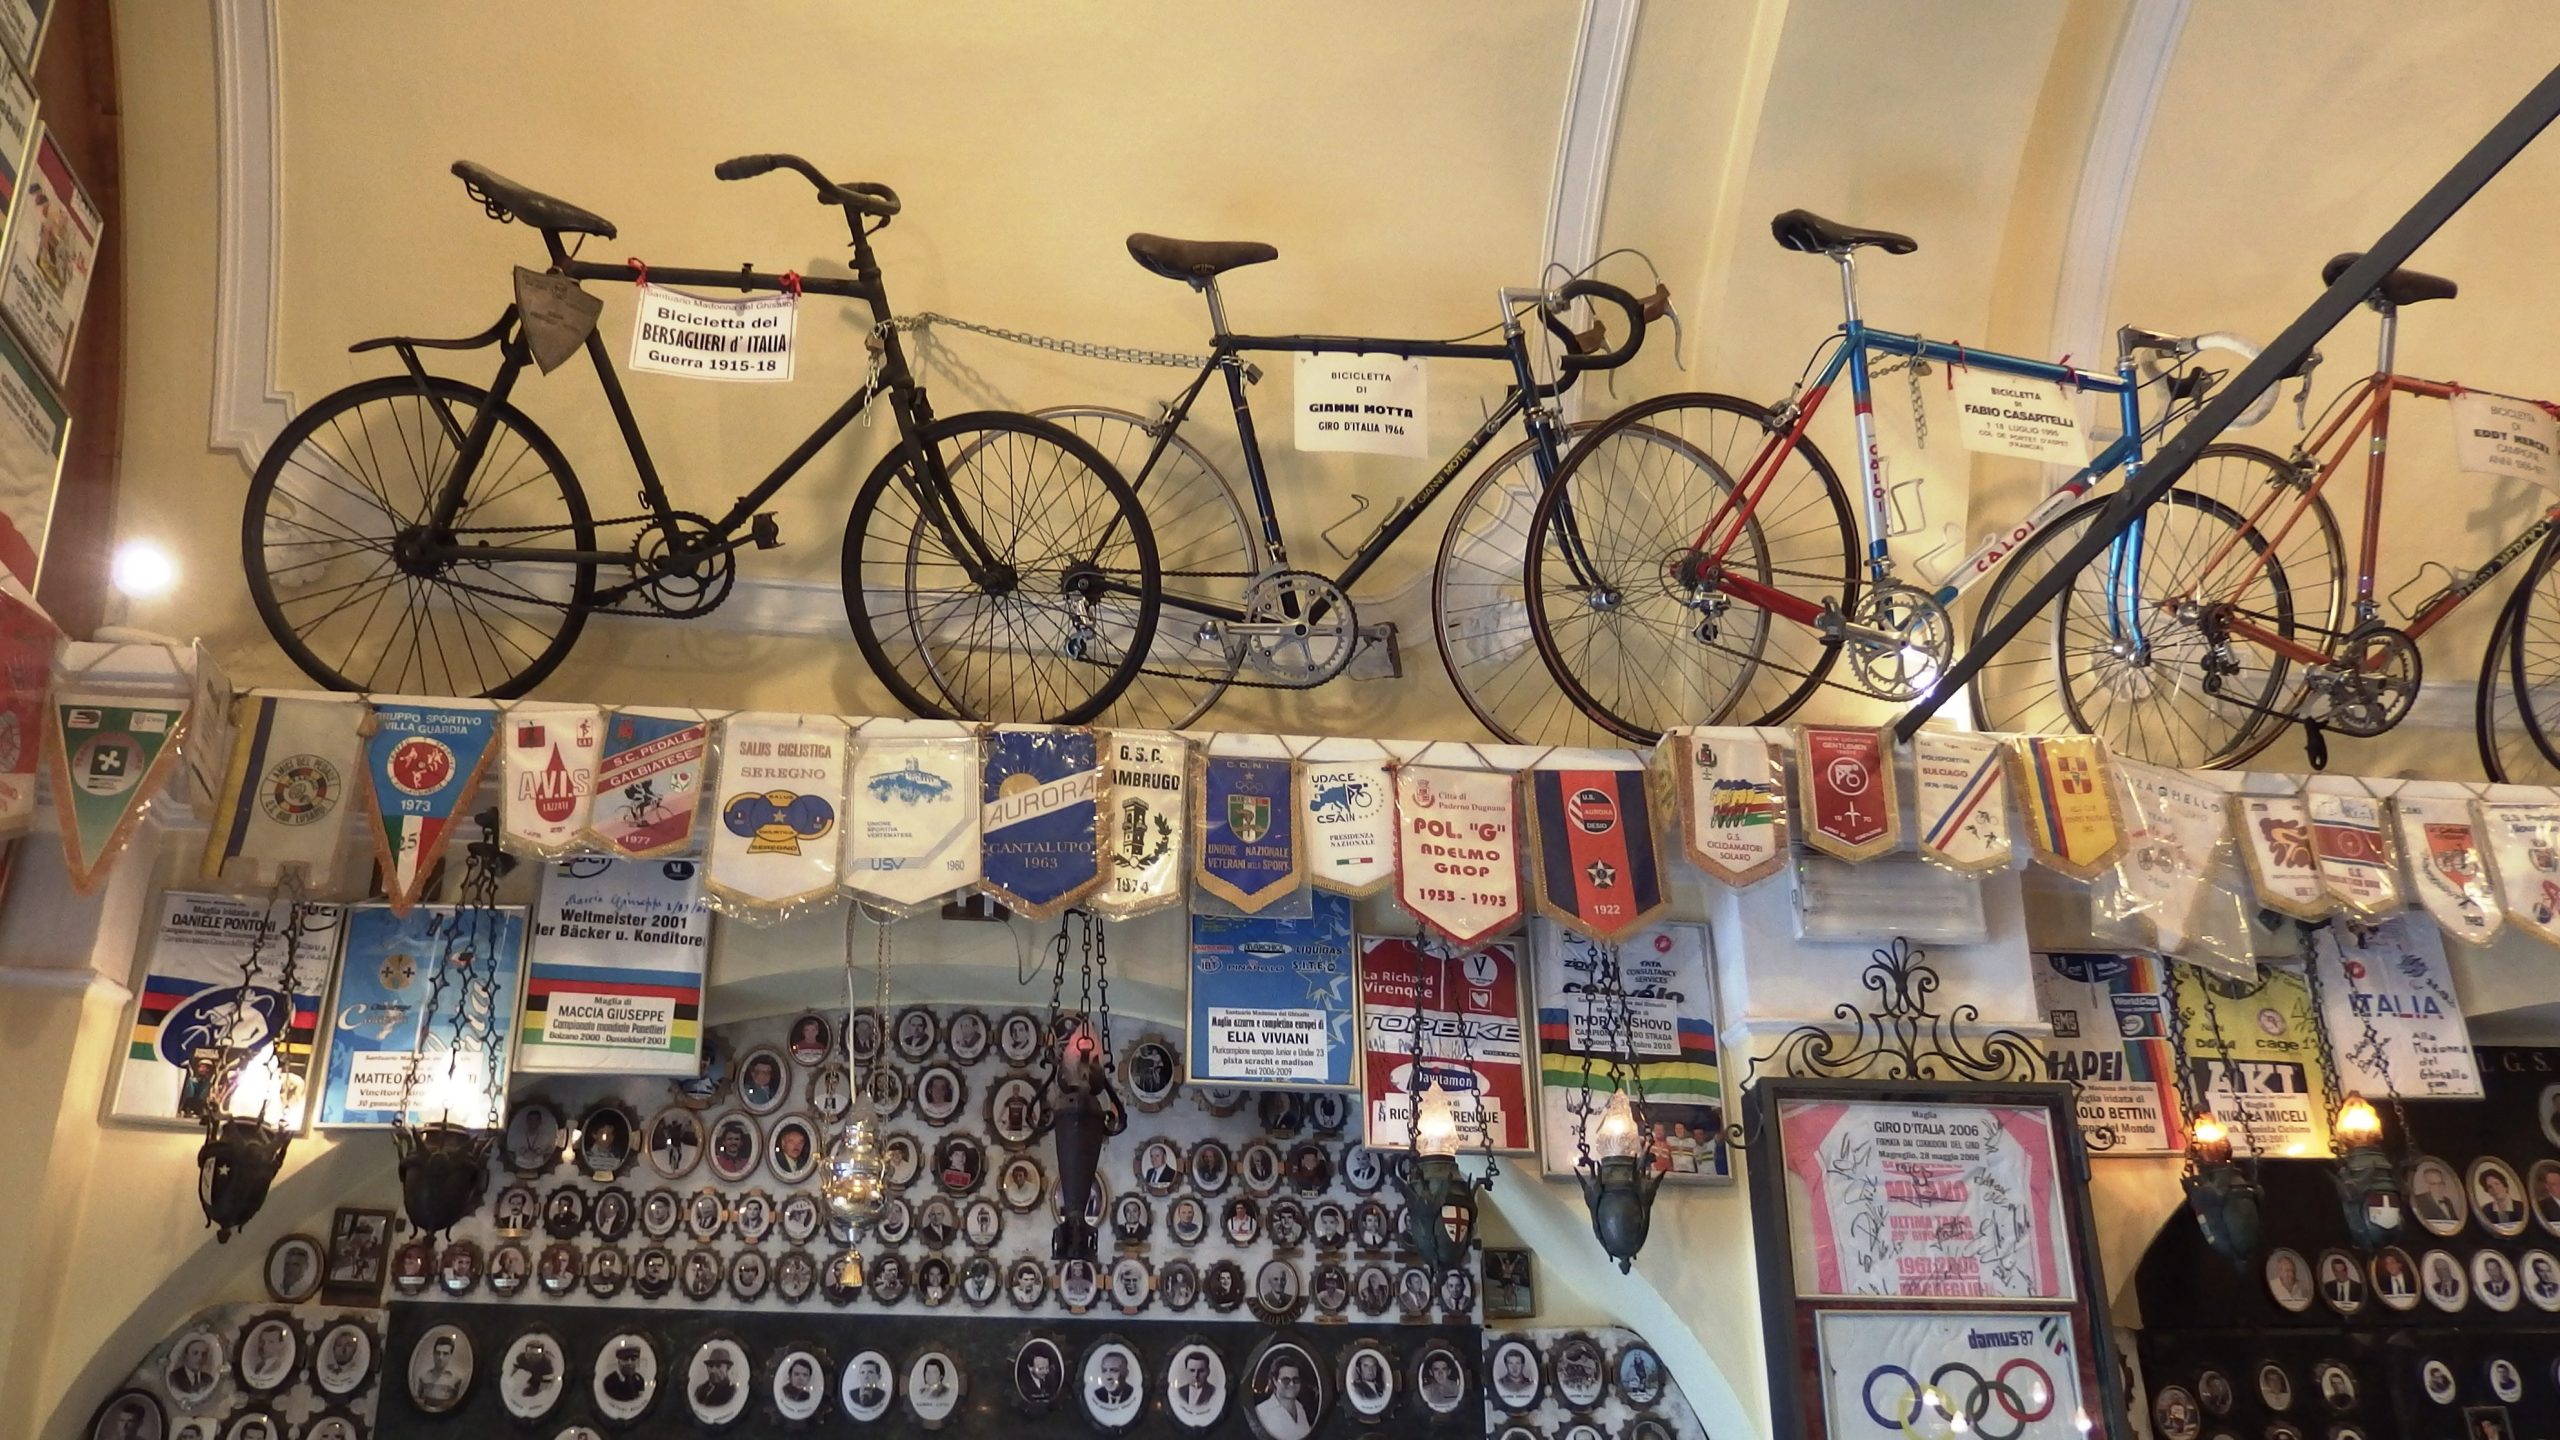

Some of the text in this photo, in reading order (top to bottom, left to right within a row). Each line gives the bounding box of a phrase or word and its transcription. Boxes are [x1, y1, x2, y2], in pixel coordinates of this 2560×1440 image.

[658, 307, 777, 329] Bicicletta dei
[643, 323, 725, 352] BERSAGLIERI
[747, 334, 786, 353] ITALIA
[649, 350, 776, 372] Guerra 1915-18
[1331, 372, 1392, 382] BICICLETTA
[1356, 386, 1367, 394] DI
[1990, 387, 2042, 401] BICICLETTA
[1309, 404, 1414, 418] GIANNI MOTTA
[1964, 404, 2074, 428] FABIO CASARTELLI
[1318, 421, 1405, 436] GIRO D'ITALIA 1966
[2008, 424, 2039, 435] LUGLIO
[1417, 447, 1472, 504] GIANNI MOTTA
[1976, 520, 2035, 573] CALOI
[426, 714, 482, 726] SPORTIVO
[384, 722, 468, 735] VILLA GUARDIA
[613, 735, 692, 767] S.C. PEDALE
[739, 741, 832, 759] SALUS CICLISTICA
[610, 751, 695, 786] GALBIATESE
[740, 767, 826, 780] SEREGNO
[1922, 767, 1968, 777] BULCIAGO
[1311, 773, 1356, 783] UDACE
[989, 775, 1094, 826] AURORA
[1460, 792, 1467, 800] di
[400, 799, 431, 812] 1973
[1438, 803, 1469, 811] Paderno
[1414, 818, 1462, 839] POL.
[624, 835, 651, 845] 1977
[1330, 832, 1374, 841] PRESIDENZA
[1727, 833, 1742, 841] G.S.
[989, 842, 1091, 854] CANTALUPO
[1330, 839, 1375, 847] NAZIONALE
[1707, 841, 1763, 852] CICLOAMATORI
[1208, 844, 1289, 858] UNIONE NAZIONALE
[1421, 844, 1500, 861] ADELMO
[1720, 851, 1751, 861] SOLARO
[871, 857, 906, 871] USV
[946, 859, 965, 871] 1960
[1024, 857, 1058, 869] 1963
[1208, 857, 1290, 871] VETERANI SPORT
[1434, 863, 1490, 877] GROP
[1419, 888, 1507, 907] 1953 1993
[1594, 905, 1620, 915] 1922
[172, 914, 221, 929] DANIELE
[561, 908, 687, 929] Weltmeister 2001
[560, 924, 628, 942] Bäcker u.
[1363, 970, 1378, 981] La
[1626, 968, 1676, 976] CONSULTANCY
[594, 996, 632, 1005] Maglia di
[2348, 994, 2445, 1019] ITALIA
[558, 1006, 664, 1022] MACCIA GIUSEPPE
[1212, 1016, 1232, 1028] Maglia
[1365, 1012, 1520, 1042] TOPBIKE
[549, 1031, 578, 1041] Bolzano
[580, 1032, 600, 1041] 2000
[647, 1037, 666, 1045] 2001
[1227, 1031, 1309, 1044] ELIA VIVIANI
[1645, 1032, 1672, 1041] STRADA
[2256, 1039, 2300, 1050] cage
[2413, 1043, 2468, 1054] Madonna
[1223, 1057, 1242, 1066] pista
[1281, 1058, 1313, 1066] madison
[2419, 1057, 2438, 1066] del
[354, 1073, 402, 1084] MATTEO
[2207, 1060, 2294, 1093] AKI
[2420, 1069, 2469, 1080] Ghisallo
[2136, 1096, 2145, 1104] di
[1912, 1110, 1937, 1121] Maglia
[2109, 1107, 2157, 1120] BETTINI
[2266, 1111, 2308, 1122] MICELI
[1874, 1121, 1979, 1136] GIRO D'ITALIA 2006
[2122, 1124, 2156, 1133] Mondo
[1903, 1139, 1914, 1149] DAI
[1951, 1140, 1962, 1149] DEL
[1965, 1140, 1980, 1149] GIRO
[1931, 1154, 1958, 1162] maggio
[1960, 1153, 1980, 1161] 2006
[1890, 1216, 1932, 1229] ULTIMA
